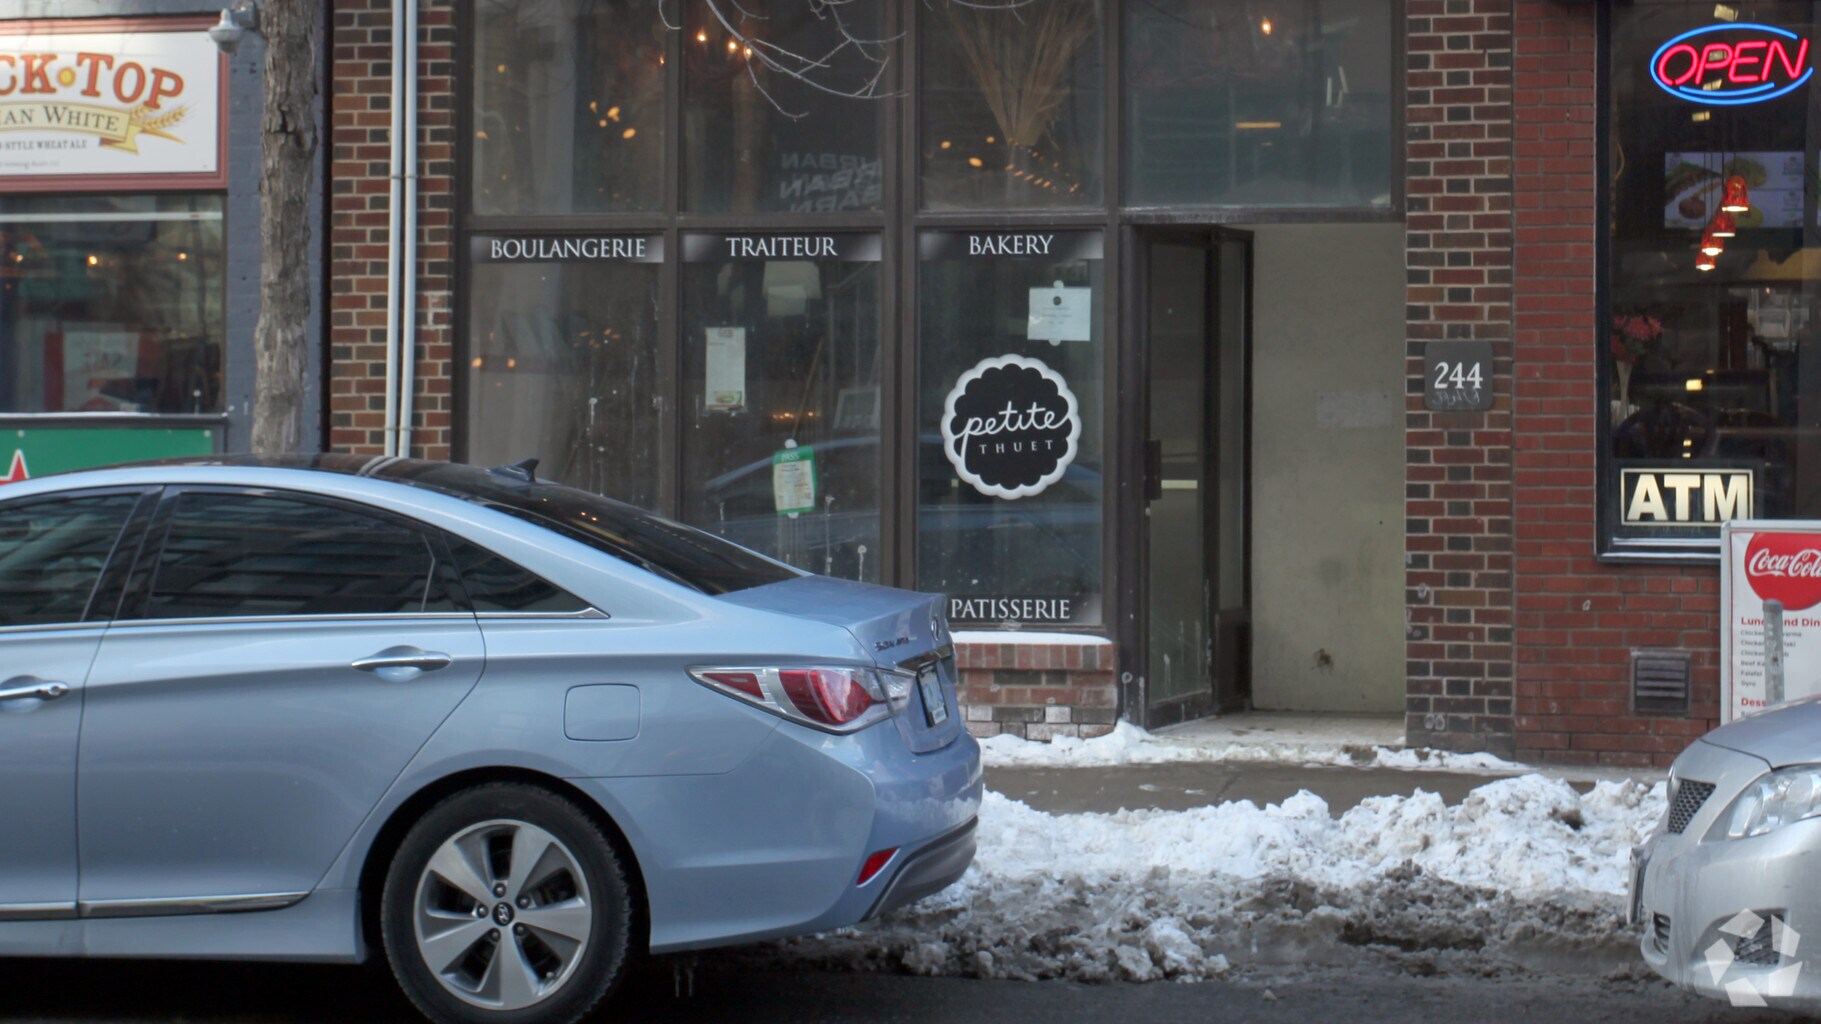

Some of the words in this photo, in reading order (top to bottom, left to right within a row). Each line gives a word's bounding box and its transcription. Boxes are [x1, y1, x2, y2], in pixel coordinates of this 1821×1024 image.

[1658, 39, 1809, 85] OPEN
[76, 52, 185, 110] TOP
[43, 104, 120, 133] WHITE
[36, 139, 69, 150] WHEAT
[70, 139, 88, 150] ALE
[490, 238, 647, 259] BOULANGERIE
[725, 237, 839, 257] TRAITEUR
[968, 234, 1055, 256] BAKERY
[1434, 361, 1484, 389] 244
[956, 400, 1070, 462] petite
[979, 439, 1054, 455] THUET
[1627, 474, 1749, 521] ATM
[950, 598, 1071, 620] PATISSERIE
[1741, 617, 1765, 626] Lunc
[1802, 618, 1821, 627] Din
[1741, 697, 1768, 707] Dess
